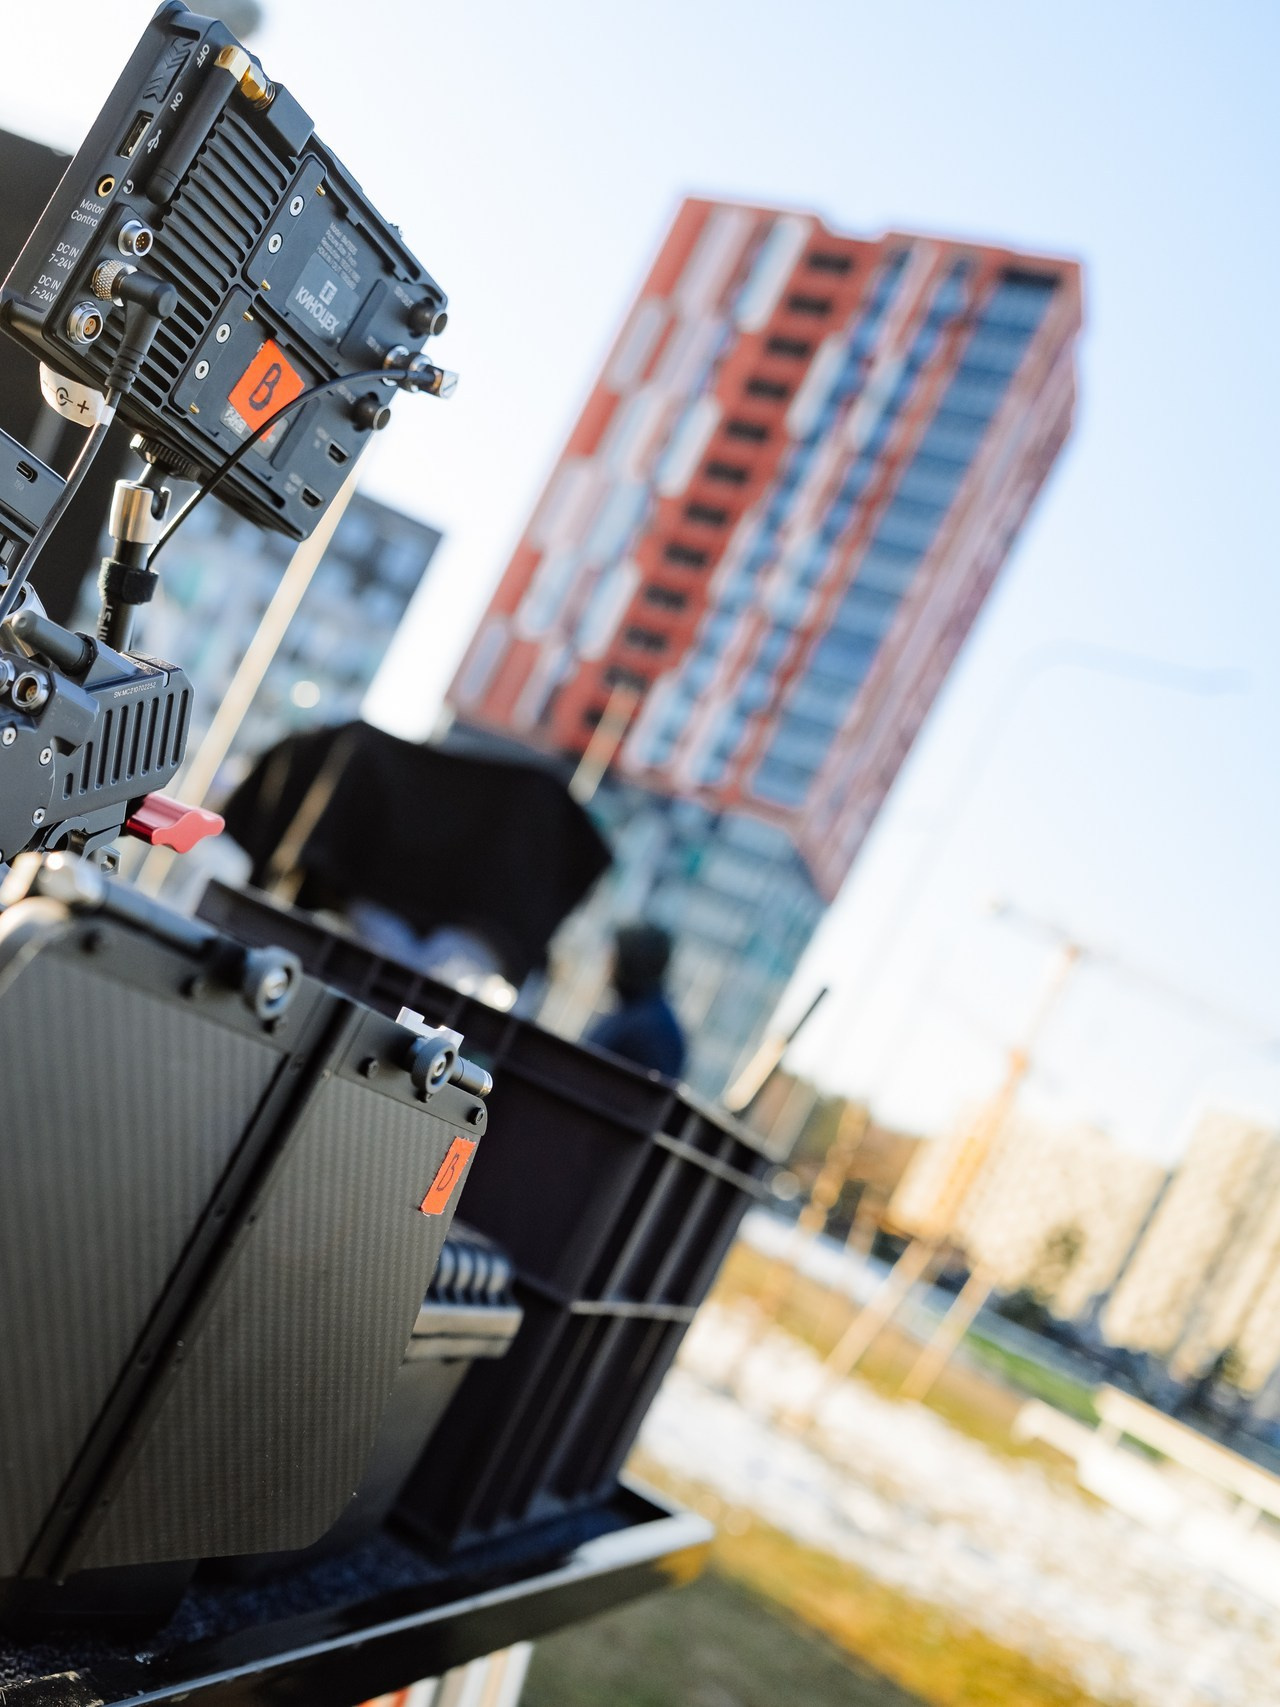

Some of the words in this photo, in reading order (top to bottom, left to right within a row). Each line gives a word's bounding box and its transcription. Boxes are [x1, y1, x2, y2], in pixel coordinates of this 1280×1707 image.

[196, 43, 210, 69] OFF
[169, 91, 183, 112] ON
[79, 198, 105, 215] Motor
[56, 242, 70, 254] DC
[68, 247, 80, 258] IN
[38, 274, 52, 287] DC
[50, 280, 62, 291] IN
[295, 285, 340, 335] КИНОЦЕХ
[248, 362, 282, 412] B
[436, 1152, 460, 1192] B
